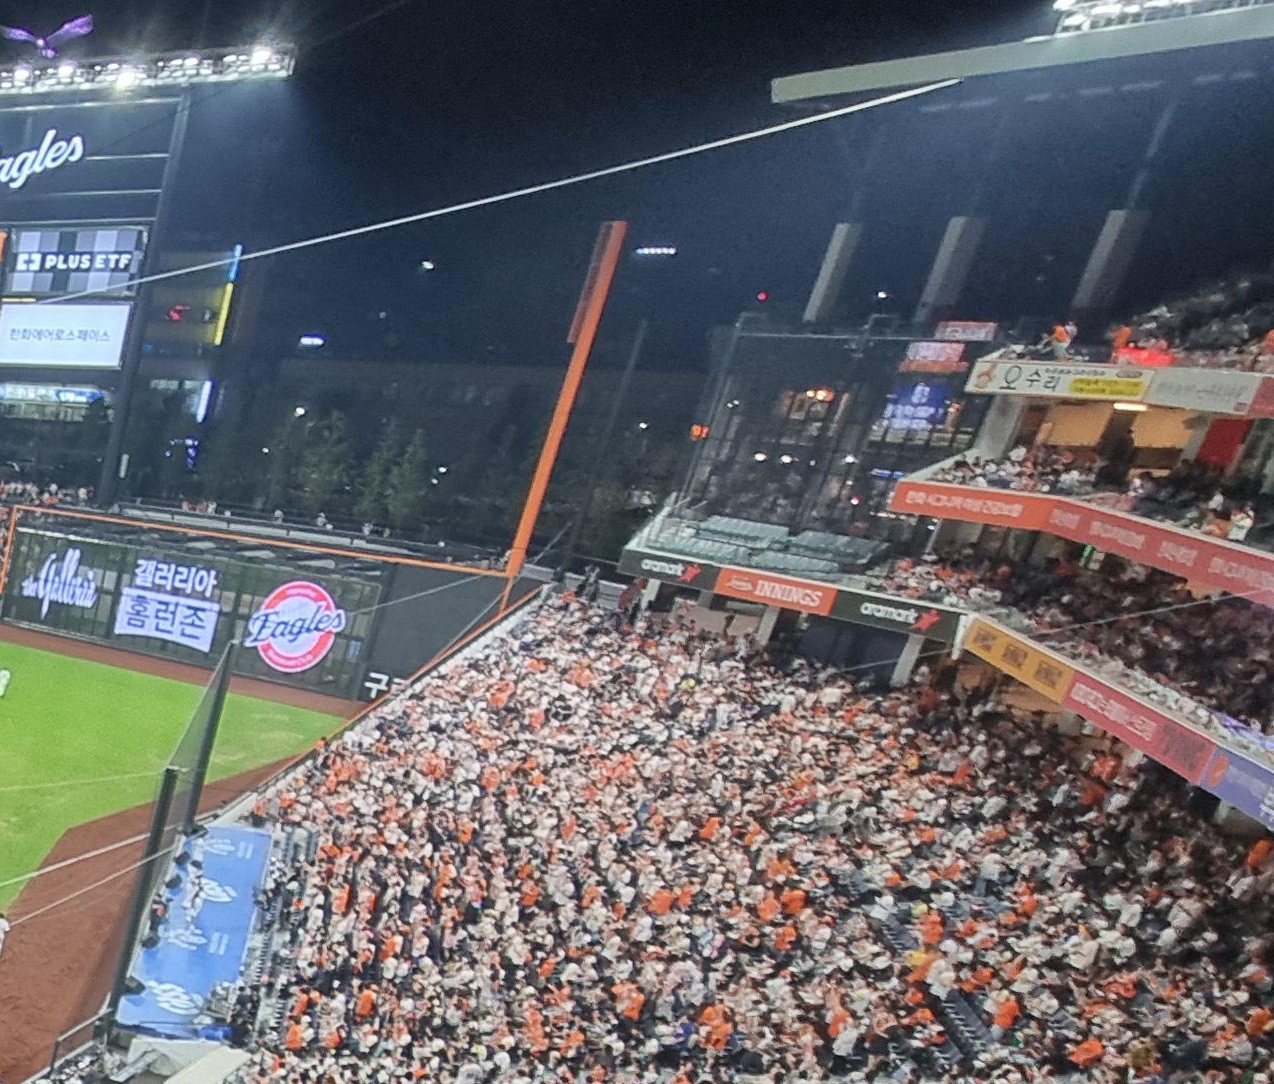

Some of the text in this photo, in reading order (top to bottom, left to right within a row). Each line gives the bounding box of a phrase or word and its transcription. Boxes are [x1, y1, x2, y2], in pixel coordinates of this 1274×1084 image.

[44, 253, 132, 269] PLUS ETF
[134, 558, 218, 598] 갤러리아
[754, 579, 823, 608] INNINGS
[125, 594, 207, 640] 홈런존
[247, 604, 345, 645] Eagles
[859, 602, 918, 625] aramark
